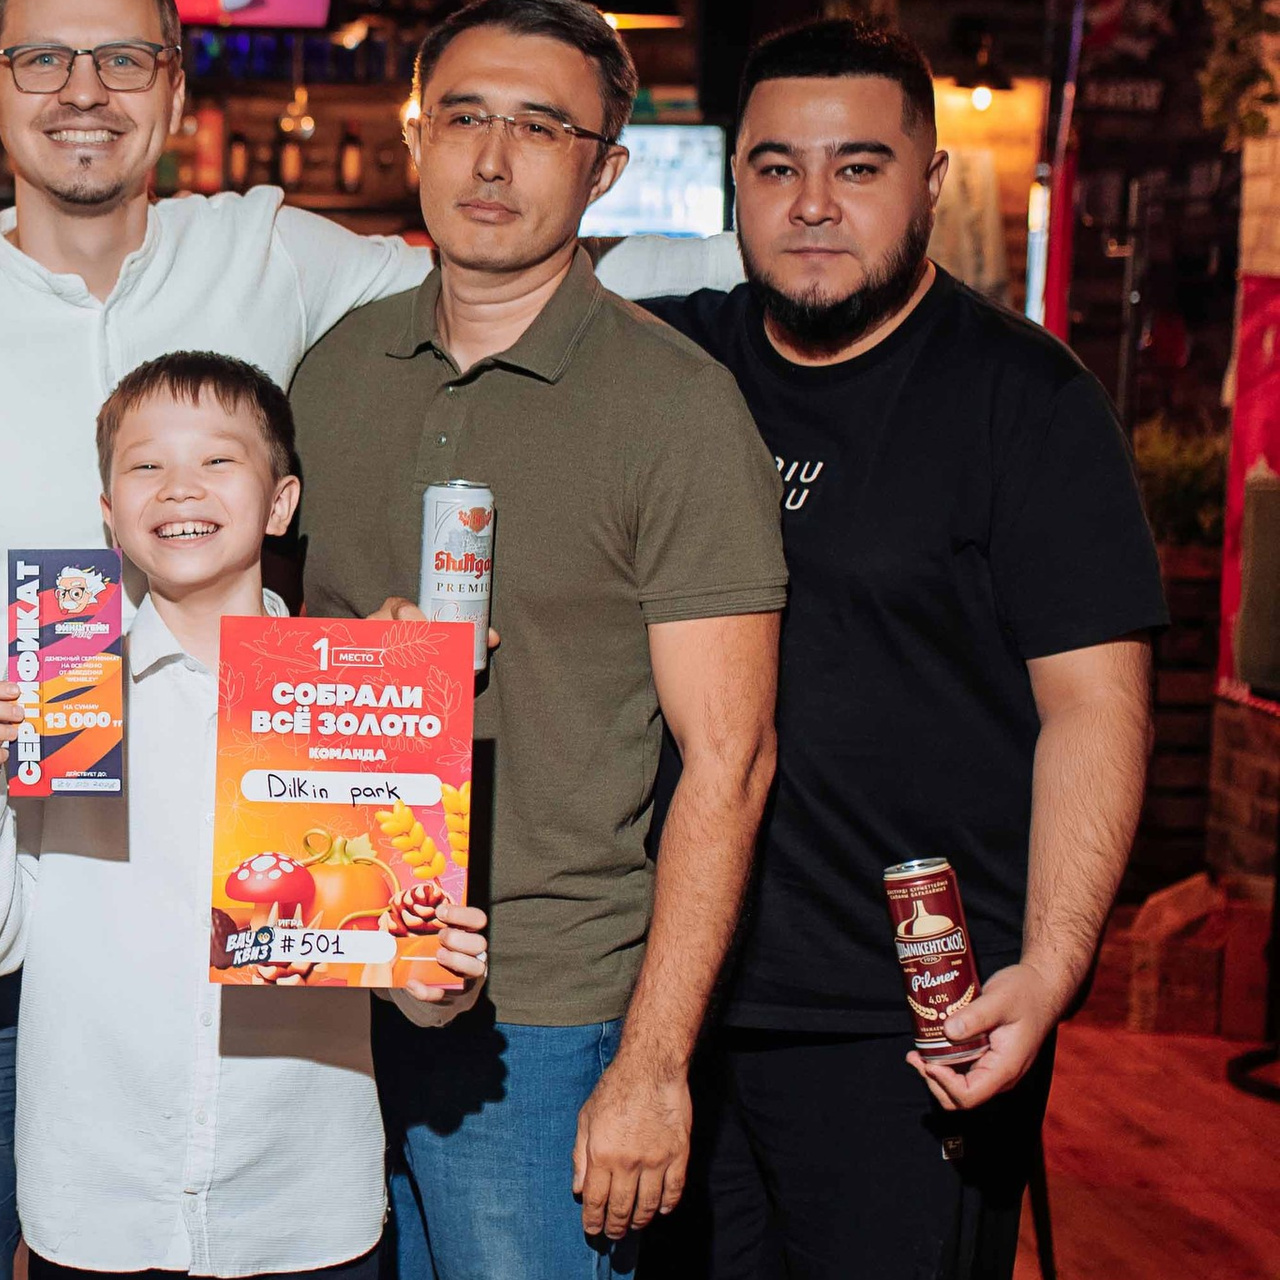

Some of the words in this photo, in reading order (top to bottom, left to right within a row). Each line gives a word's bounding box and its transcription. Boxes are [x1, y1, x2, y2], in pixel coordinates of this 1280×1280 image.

[437, 582, 490, 593] PREMIU
[312, 637, 329, 671] 1
[339, 653, 375, 663] МЕСТО
[17, 560, 41, 785] СЕРТИФИКАТ
[272, 682, 422, 708] СОБРАЛИ
[45, 712, 66, 728] 13
[69, 711, 111, 728] 000
[251, 706, 311, 734] ВСЁ
[317, 712, 441, 738] ЗОЛОТО
[309, 747, 386, 762] КОМАНДА
[350, 781, 401, 807] park
[277, 919, 303, 928] ИГРА
[226, 931, 255, 952] ВАУ
[895, 931, 964, 959] ШЫМКЕНТСКОЕ
[233, 945, 270, 964] КВИЗ
[912, 970, 960, 992] Pilsner
